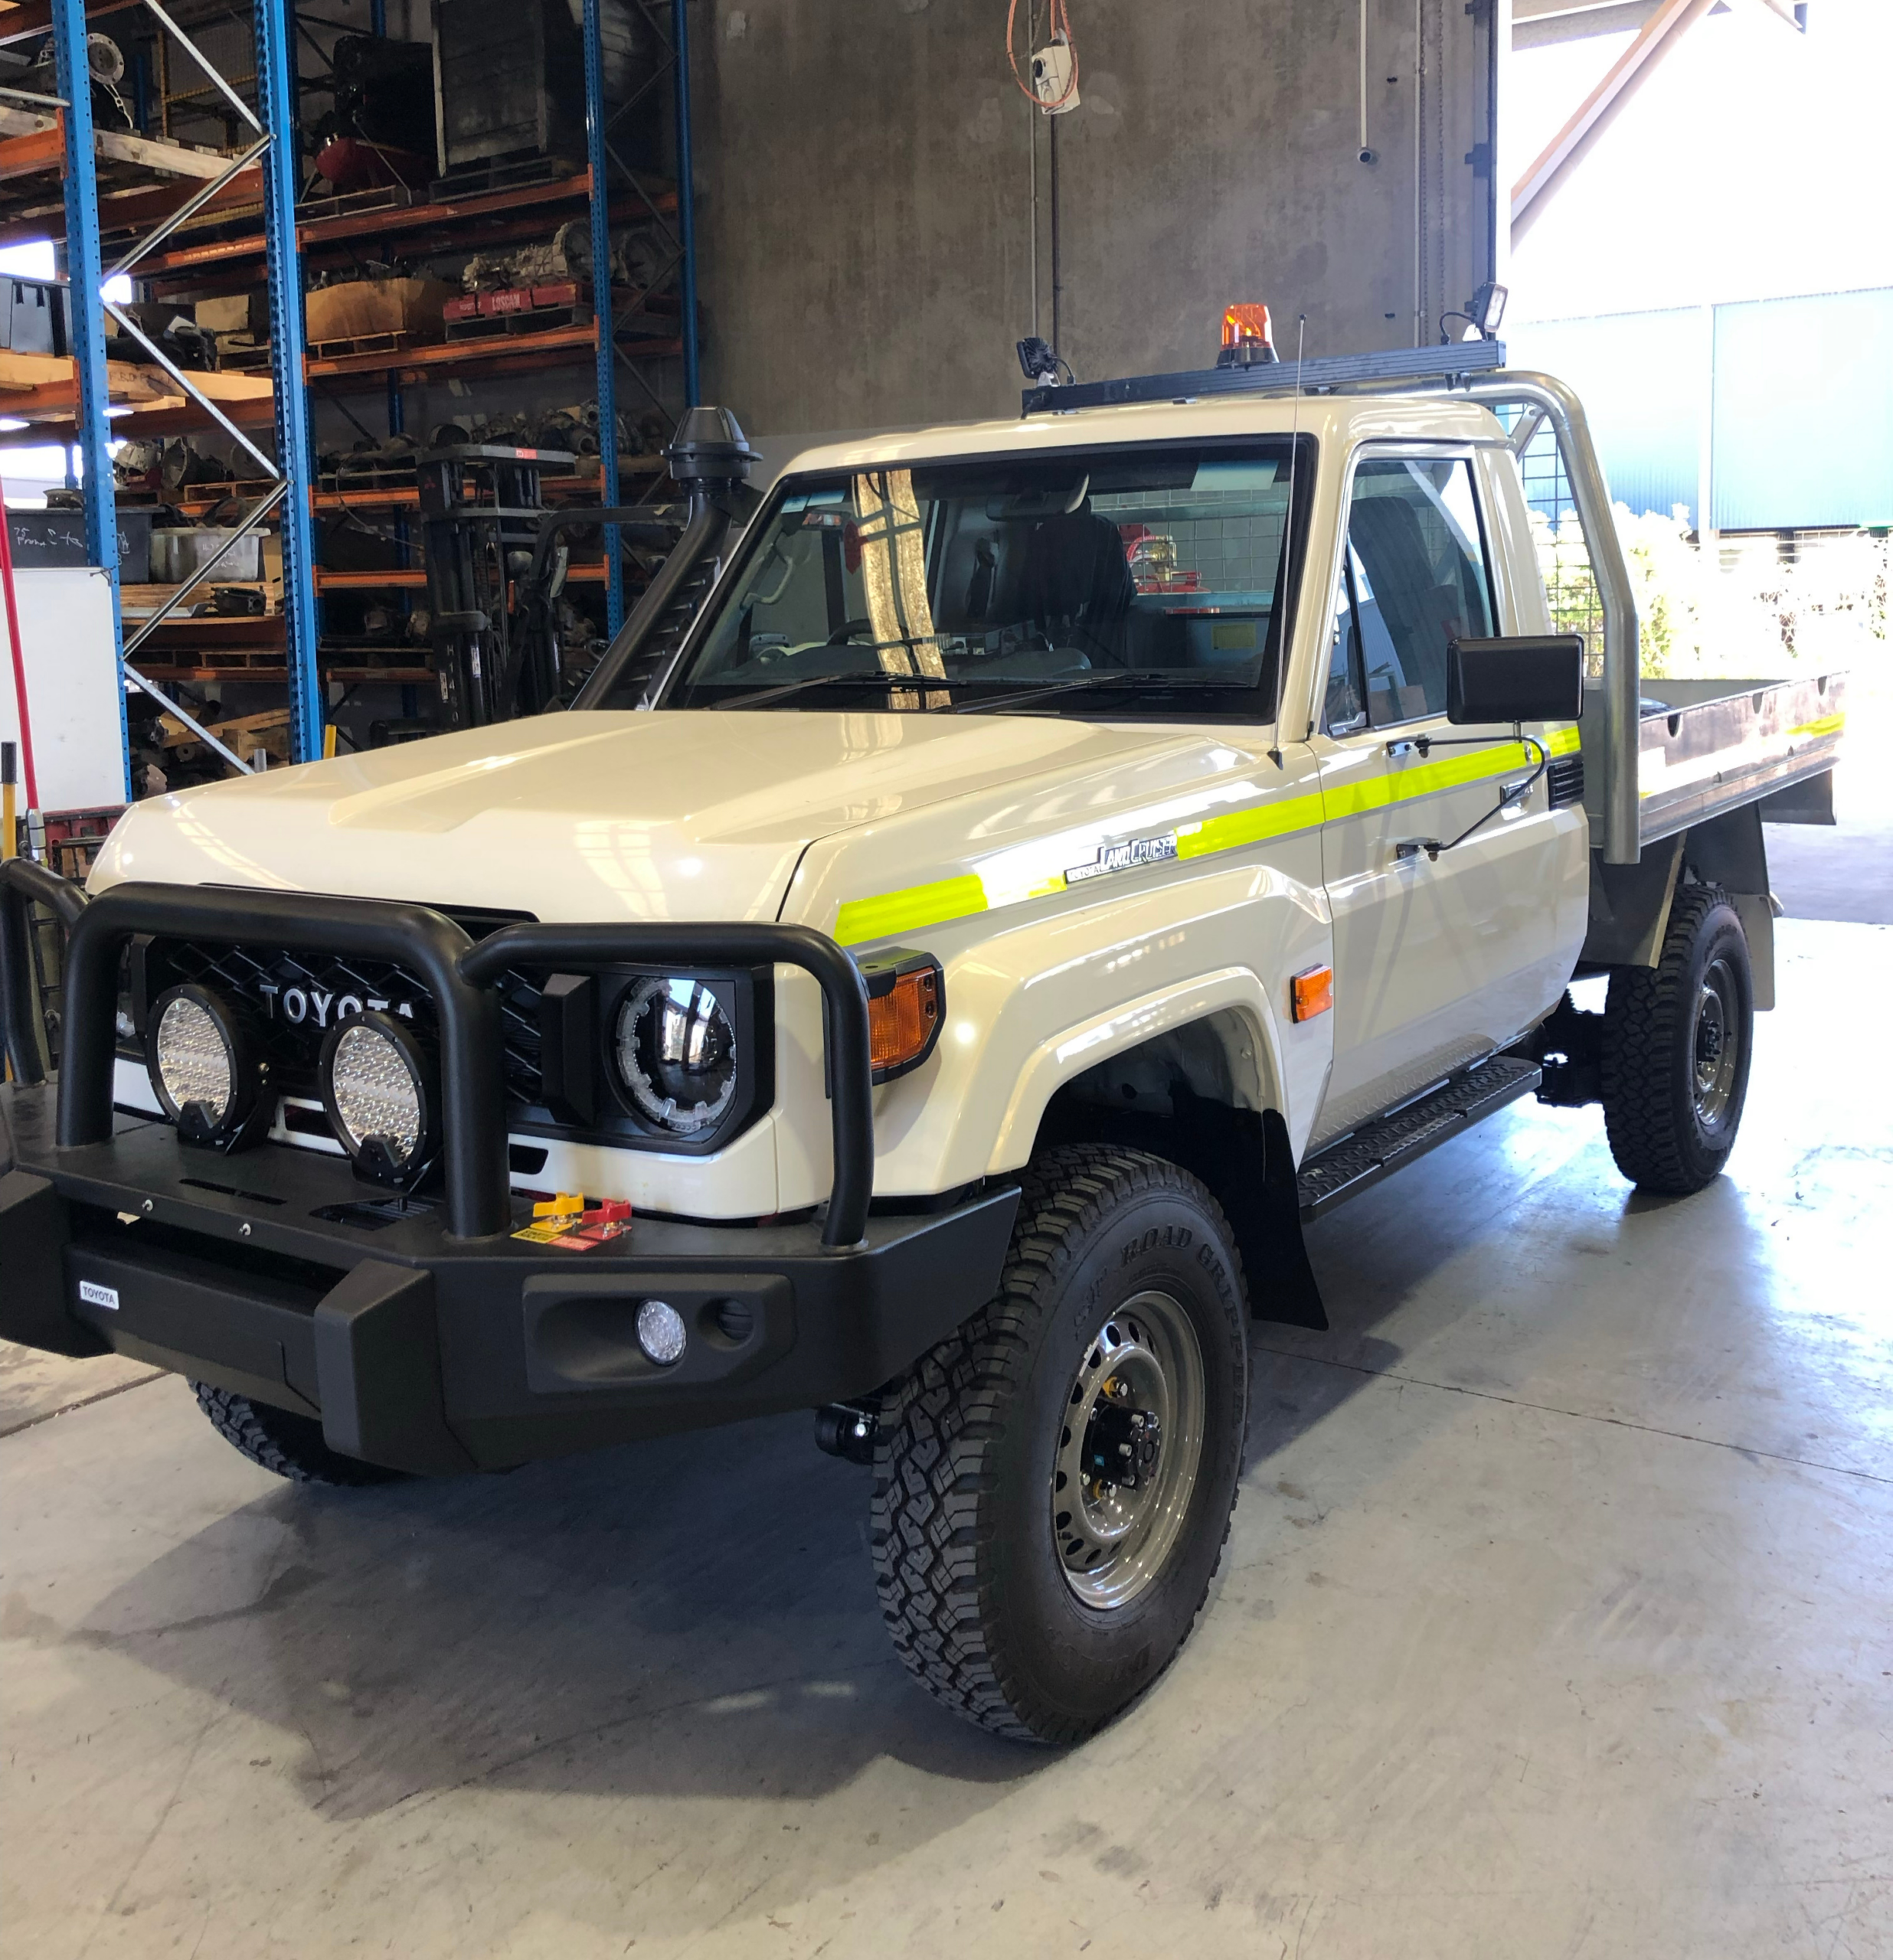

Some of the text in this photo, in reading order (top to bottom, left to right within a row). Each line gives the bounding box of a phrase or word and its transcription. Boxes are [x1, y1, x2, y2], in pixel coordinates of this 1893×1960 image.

[492, 293, 521, 312] LOSCAM
[1098, 835, 1178, 871] LAND CRUISER
[83, 1285, 116, 1305] TOYOTA
[1120, 1224, 1193, 1268] ROAD
[1196, 1243, 1244, 1429] GRIPPER
